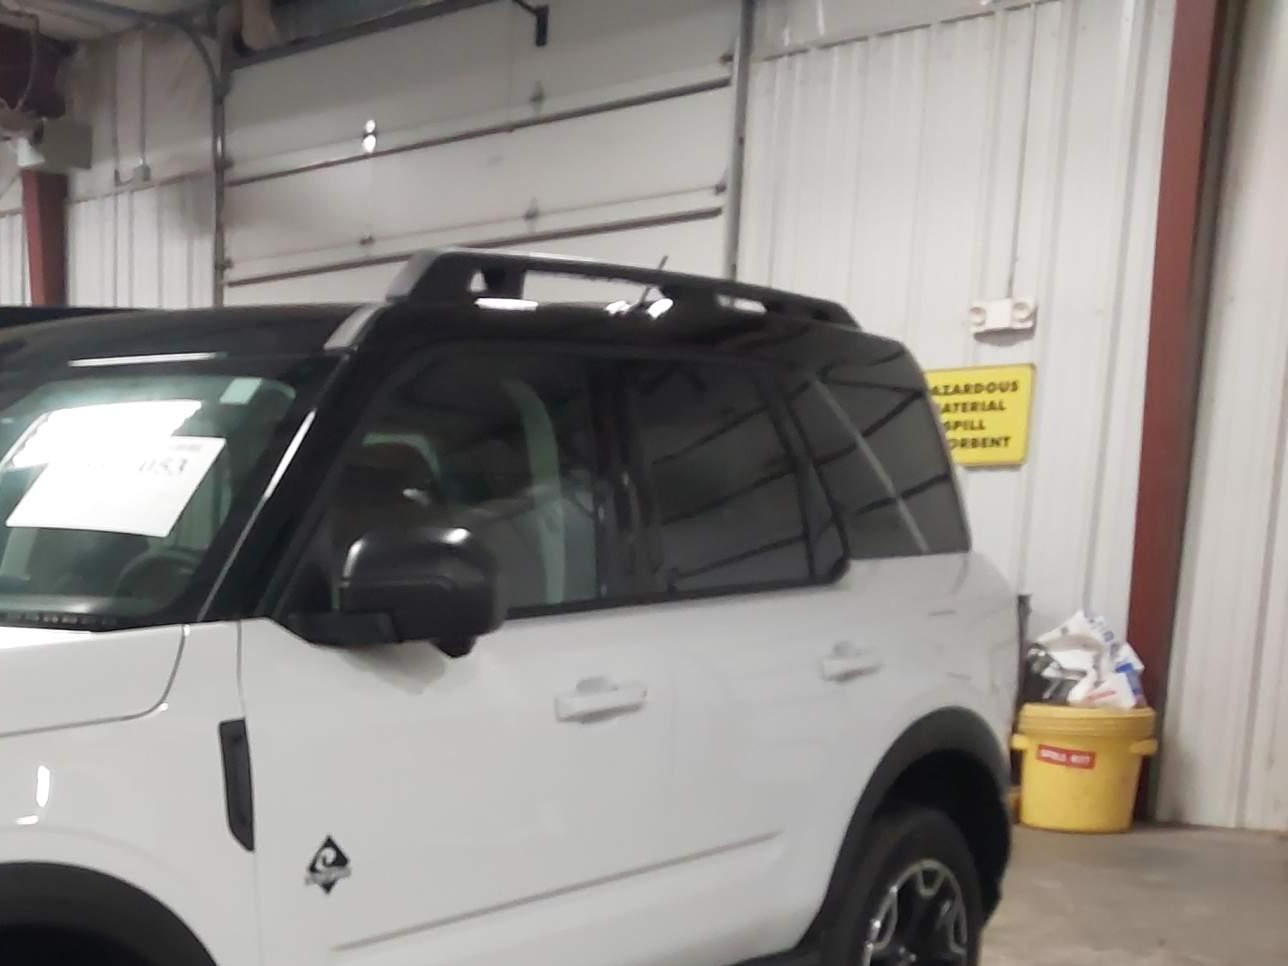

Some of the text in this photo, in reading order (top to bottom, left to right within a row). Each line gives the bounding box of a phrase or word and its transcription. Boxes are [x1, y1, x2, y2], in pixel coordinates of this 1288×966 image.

[929, 381, 1018, 396] AZARDOUS
[939, 400, 1006, 413] ATERIAL
[943, 420, 986, 431] SPILL
[948, 436, 1011, 449] ORBENT
